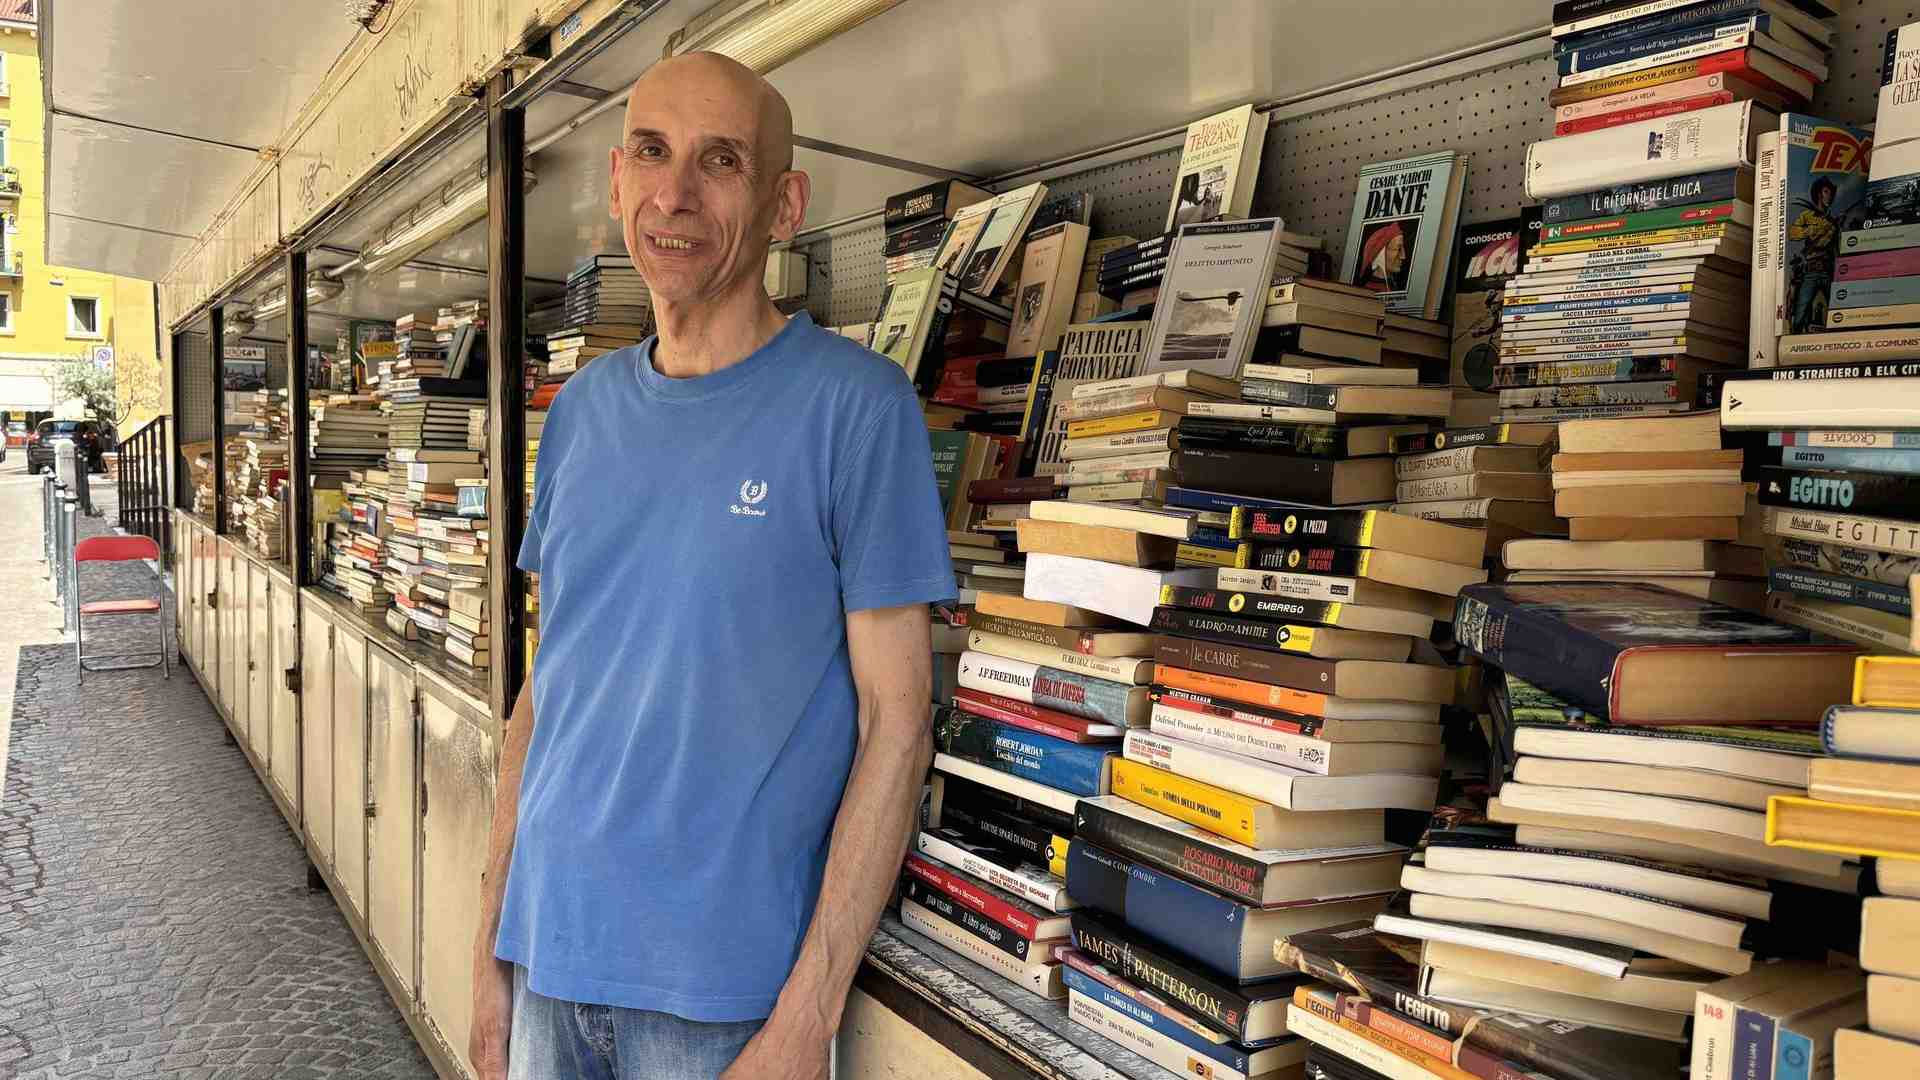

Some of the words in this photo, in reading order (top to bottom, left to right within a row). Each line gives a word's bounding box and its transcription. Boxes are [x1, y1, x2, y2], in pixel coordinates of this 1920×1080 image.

[1896, 62, 1911, 84] LA
[1190, 126, 1240, 153] TERZANI
[1811, 127, 1873, 176] TEX
[1370, 173, 1399, 190] CESARE
[1399, 168, 1433, 185] MARCHI
[1363, 182, 1430, 221] DANTE
[1591, 201, 1600, 212] IL
[1604, 190, 1647, 209] RITORNO
[1650, 188, 1670, 203] DEL
[1672, 181, 1703, 199] DUCA
[1465, 230, 1512, 247] conoscere
[1185, 258, 1215, 269] DELITTO
[1216, 256, 1253, 268] IMPUNITO
[1612, 248, 1624, 257] NEL
[1625, 246, 1650, 256] CORRAL
[1063, 327, 1143, 357] PATRICIA
[1790, 343, 1822, 354] ARRIGO
[1823, 341, 1862, 352] PETACCO
[1773, 370, 1795, 381] UNO
[1799, 367, 1860, 380] STRANIERO
[1864, 366, 1873, 377] A
[1877, 365, 1898, 378] ELK
[1823, 432, 1876, 446] CROCIATE
[1795, 452, 1825, 463] EGITTO
[1790, 476, 1855, 508] EGITTO
[1253, 513, 1267, 522] TESS
[1790, 515, 1814, 531] Michael
[1256, 601, 1306, 614] EMBARGO
[1194, 619, 1228, 633] LADRO
[1194, 647, 1203, 662] le
[1204, 648, 1240, 668] CARRÉ
[1169, 690, 1190, 701] HEATHER
[1190, 693, 1213, 705] GRAHAM
[995, 735, 1019, 751] ROBERT
[1018, 741, 1044, 758] JORDAN
[1162, 789, 1180, 805] STORIA
[1180, 795, 1196, 810] DELLE
[1196, 800, 1222, 820] PIRAMIDI
[1020, 836, 1039, 853] NOTTE
[1184, 845, 1225, 869] ROSARIO
[1188, 863, 1225, 889] STATUA
[968, 912, 980, 928] libro
[980, 920, 1002, 944] selvaggio
[1079, 929, 1119, 967] JAMES
[1133, 958, 1222, 1020] PATTERSON
[1305, 997, 1342, 1025] L'EGITTO
[1395, 991, 1451, 1033] L'EGITTO
[1703, 1003, 1726, 1022] 148
